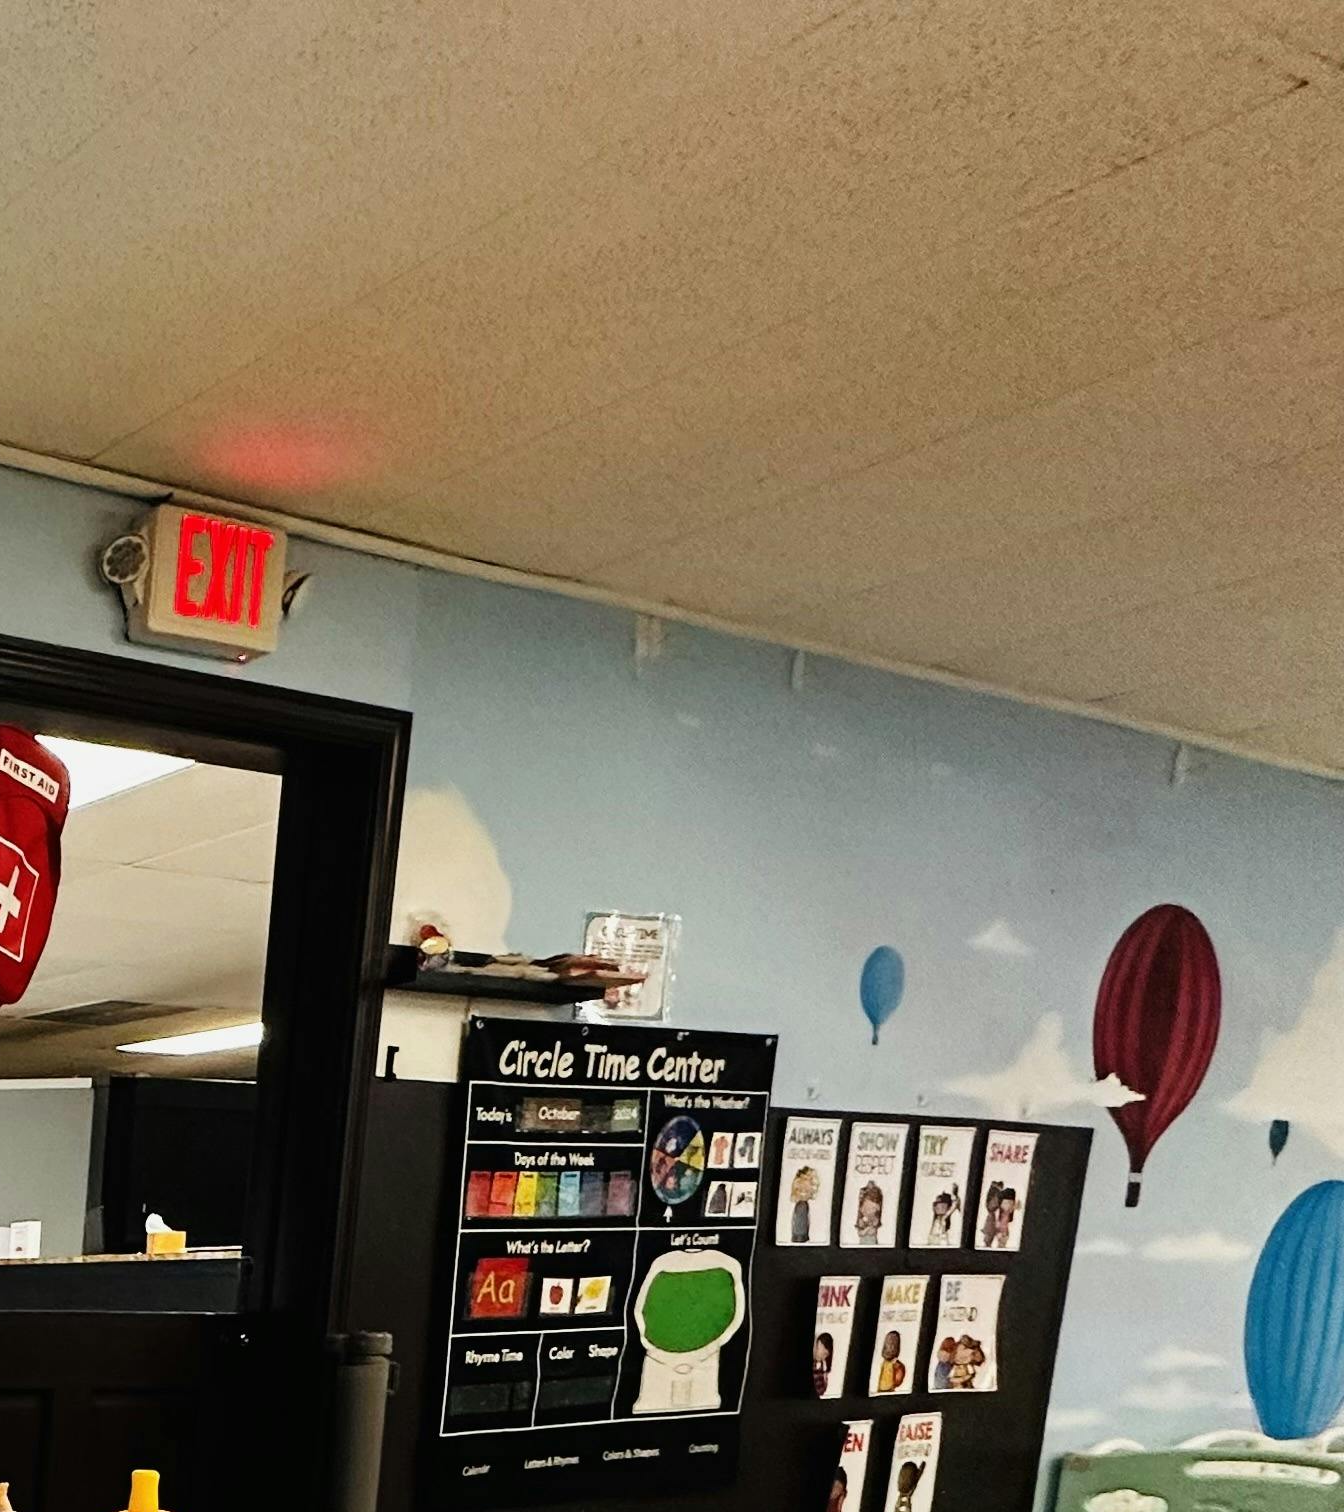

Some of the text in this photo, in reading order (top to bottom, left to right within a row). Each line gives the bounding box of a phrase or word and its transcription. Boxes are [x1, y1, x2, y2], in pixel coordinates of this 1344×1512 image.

[175, 514, 275, 629] EXIT
[3, 755, 55, 795] FIRST AID
[499, 1040, 725, 1083] Circle Time Center
[538, 1106, 581, 1121] October
[788, 1127, 834, 1146] ALWAYS
[857, 1131, 900, 1151] SHOW
[923, 1134, 949, 1156] TRY
[514, 1152, 595, 1168] Days of the Week
[990, 1142, 1030, 1164] SHARE
[506, 1240, 538, 1254] What's
[476, 1270, 516, 1304] Aa
[944, 1281, 962, 1302] BE
